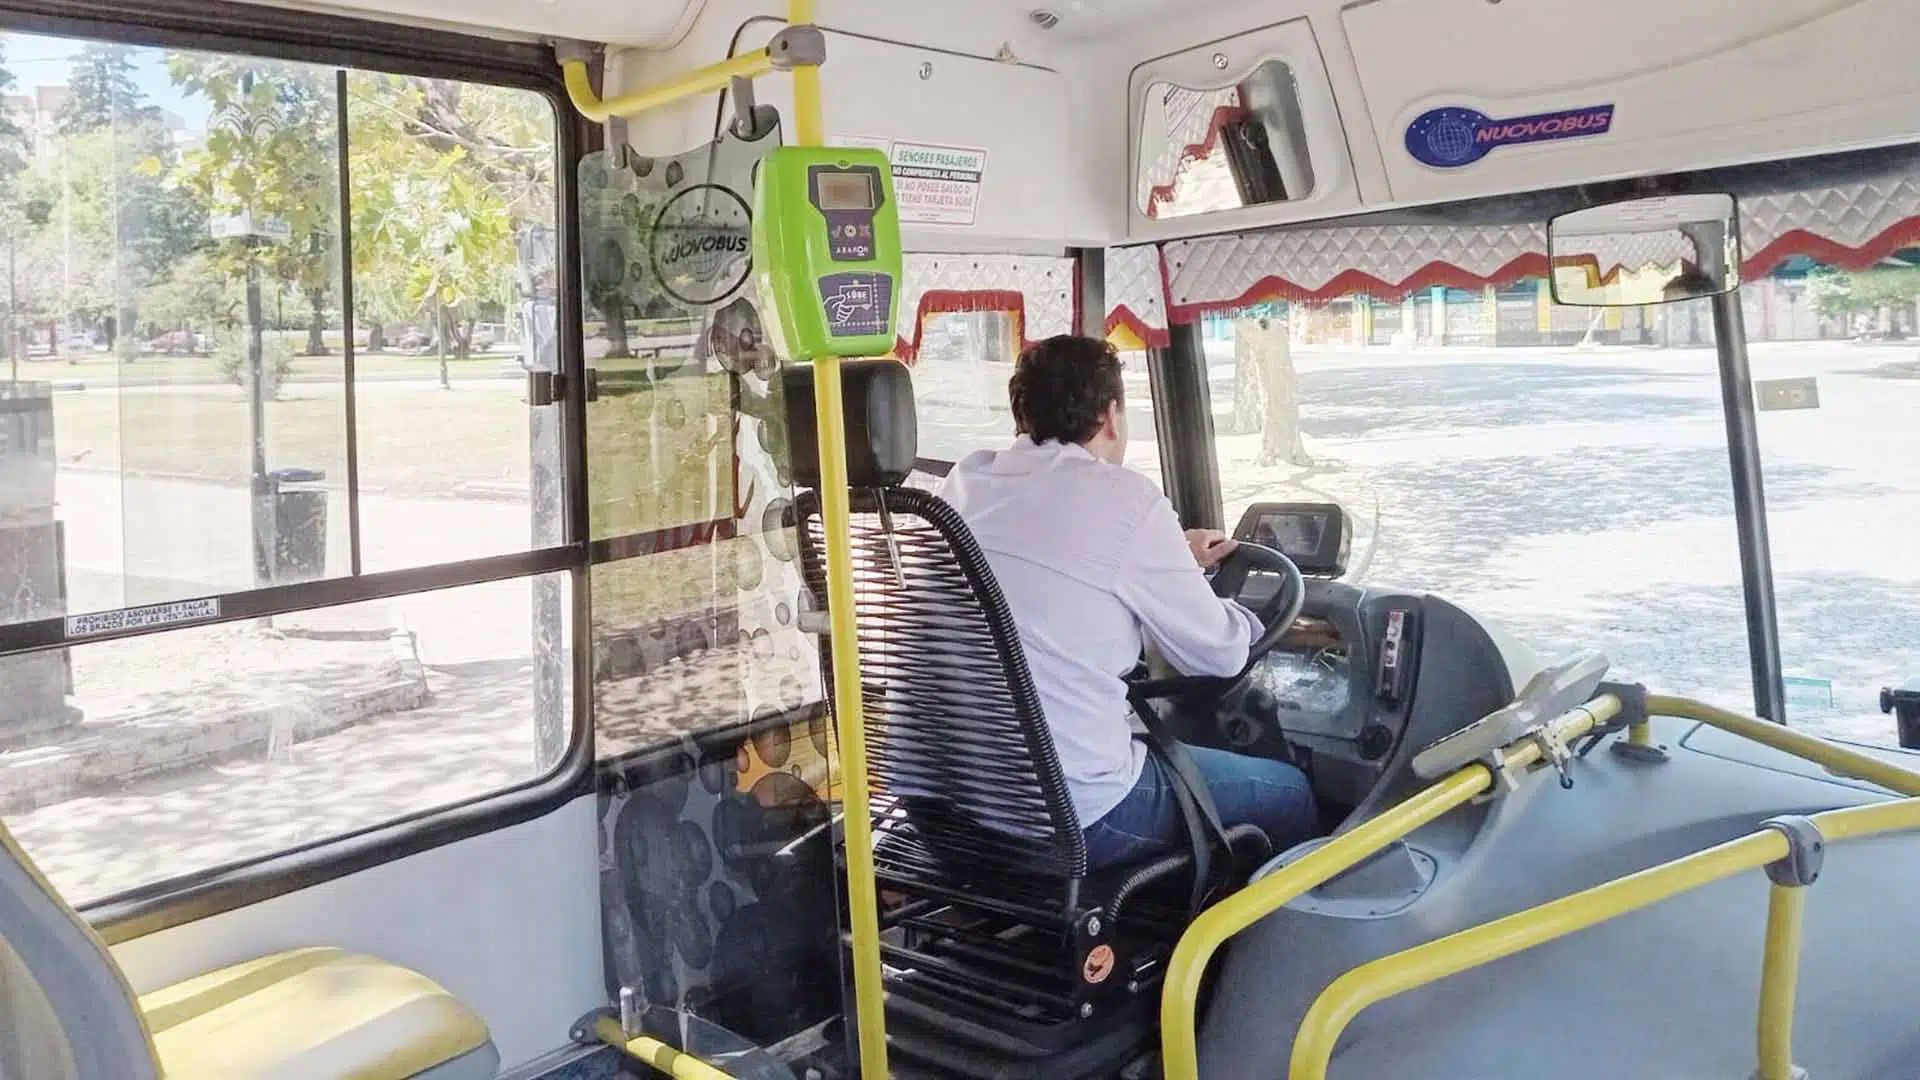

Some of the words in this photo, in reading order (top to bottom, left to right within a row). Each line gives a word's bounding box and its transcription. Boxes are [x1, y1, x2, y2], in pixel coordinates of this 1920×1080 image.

[1475, 113, 1610, 143] NUOVOBUS
[936, 153, 977, 168] PASAJEROS
[71, 623, 87, 635] LOS
[89, 619, 124, 632] BRAZOS
[126, 615, 143, 627] POR
[144, 612, 161, 624] LAS
[162, 607, 216, 622] VENTANILLAS
[77, 611, 125, 624] PROHIBIDO
[127, 606, 172, 617] ASOMARSE
[182, 600, 209, 611] SACAR
